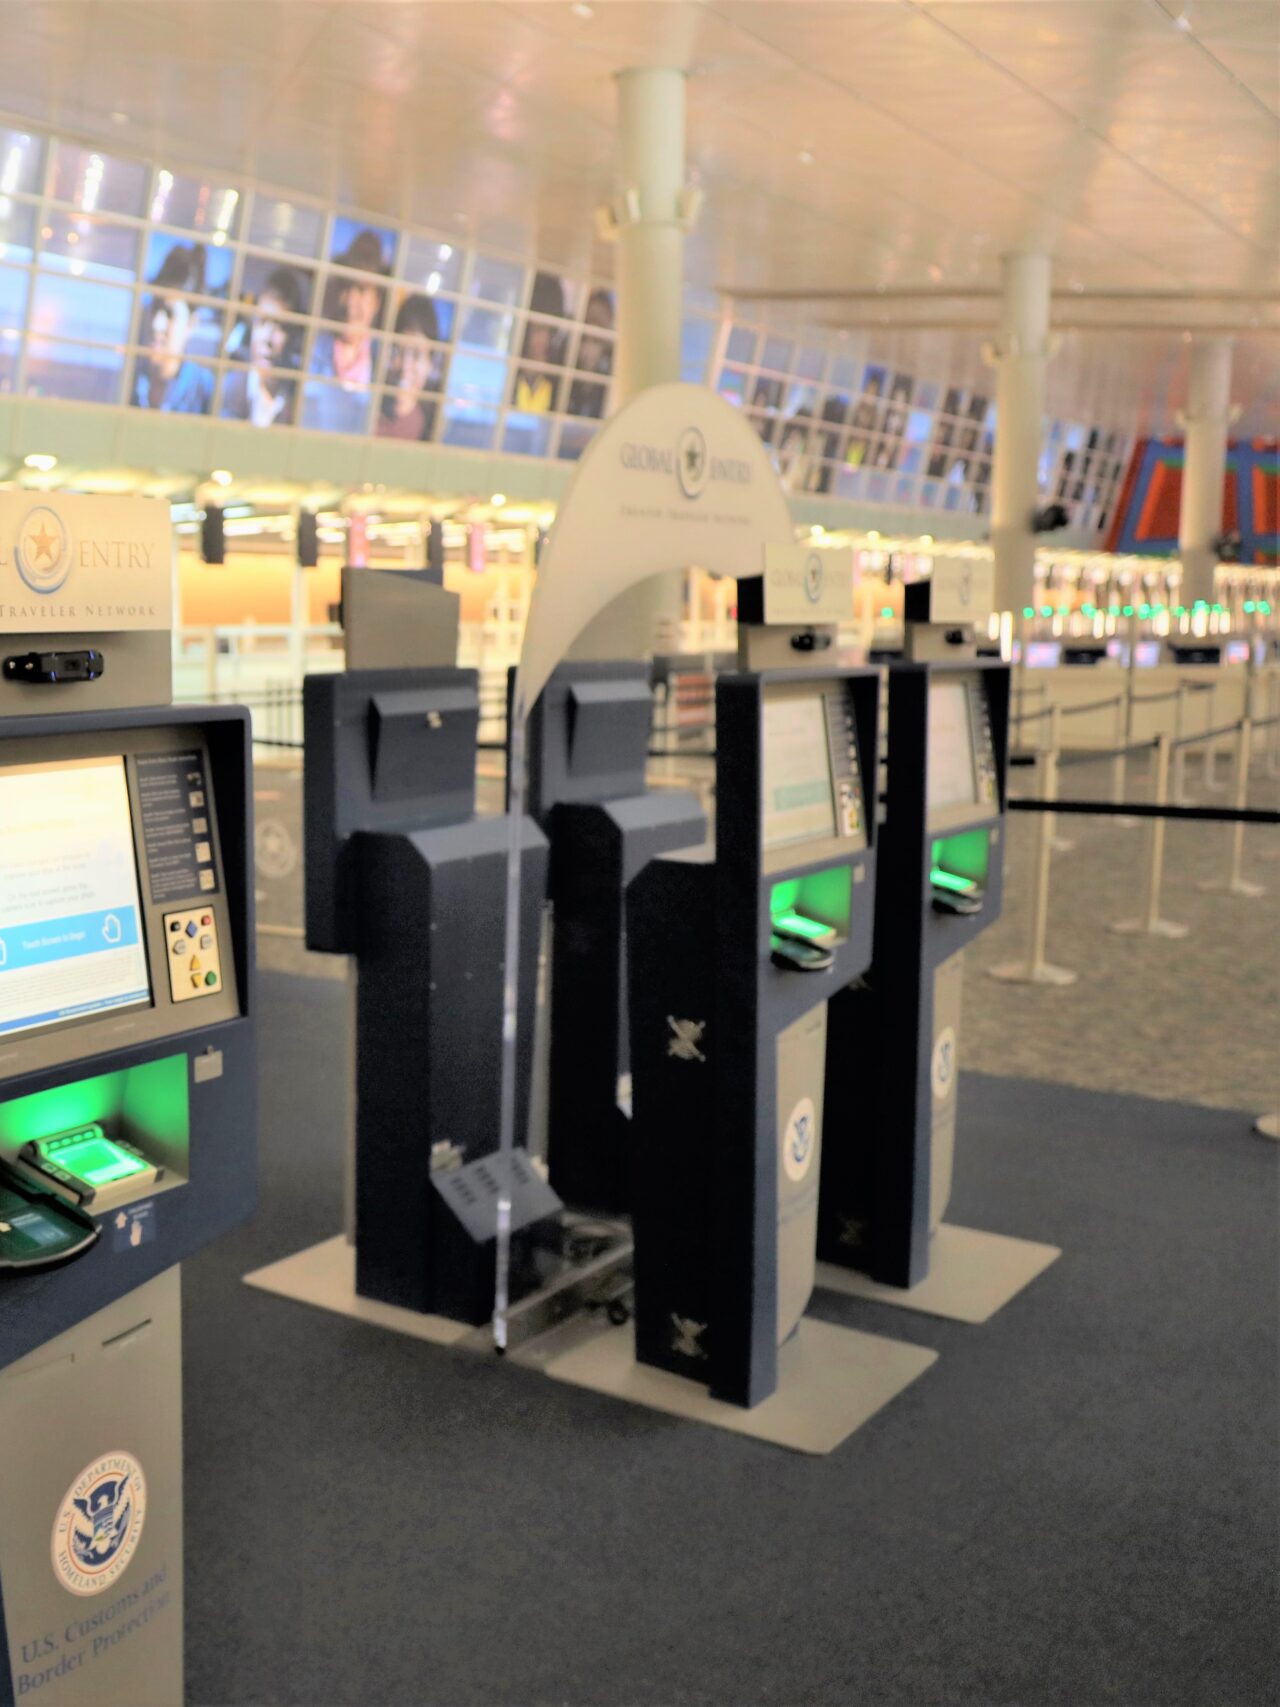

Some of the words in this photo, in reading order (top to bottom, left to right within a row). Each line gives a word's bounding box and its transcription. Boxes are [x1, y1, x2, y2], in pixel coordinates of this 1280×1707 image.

[79, 539, 155, 569] ENTRY
[86, 605, 156, 617] NETWORK
[58, 1550, 107, 1588] HOMELAND
[21, 1631, 59, 1663] U.S.
[64, 1592, 139, 1643] Customs
[141, 1560, 168, 1598] and
[17, 1649, 85, 1695] Border
[92, 1591, 171, 1657] Protection
